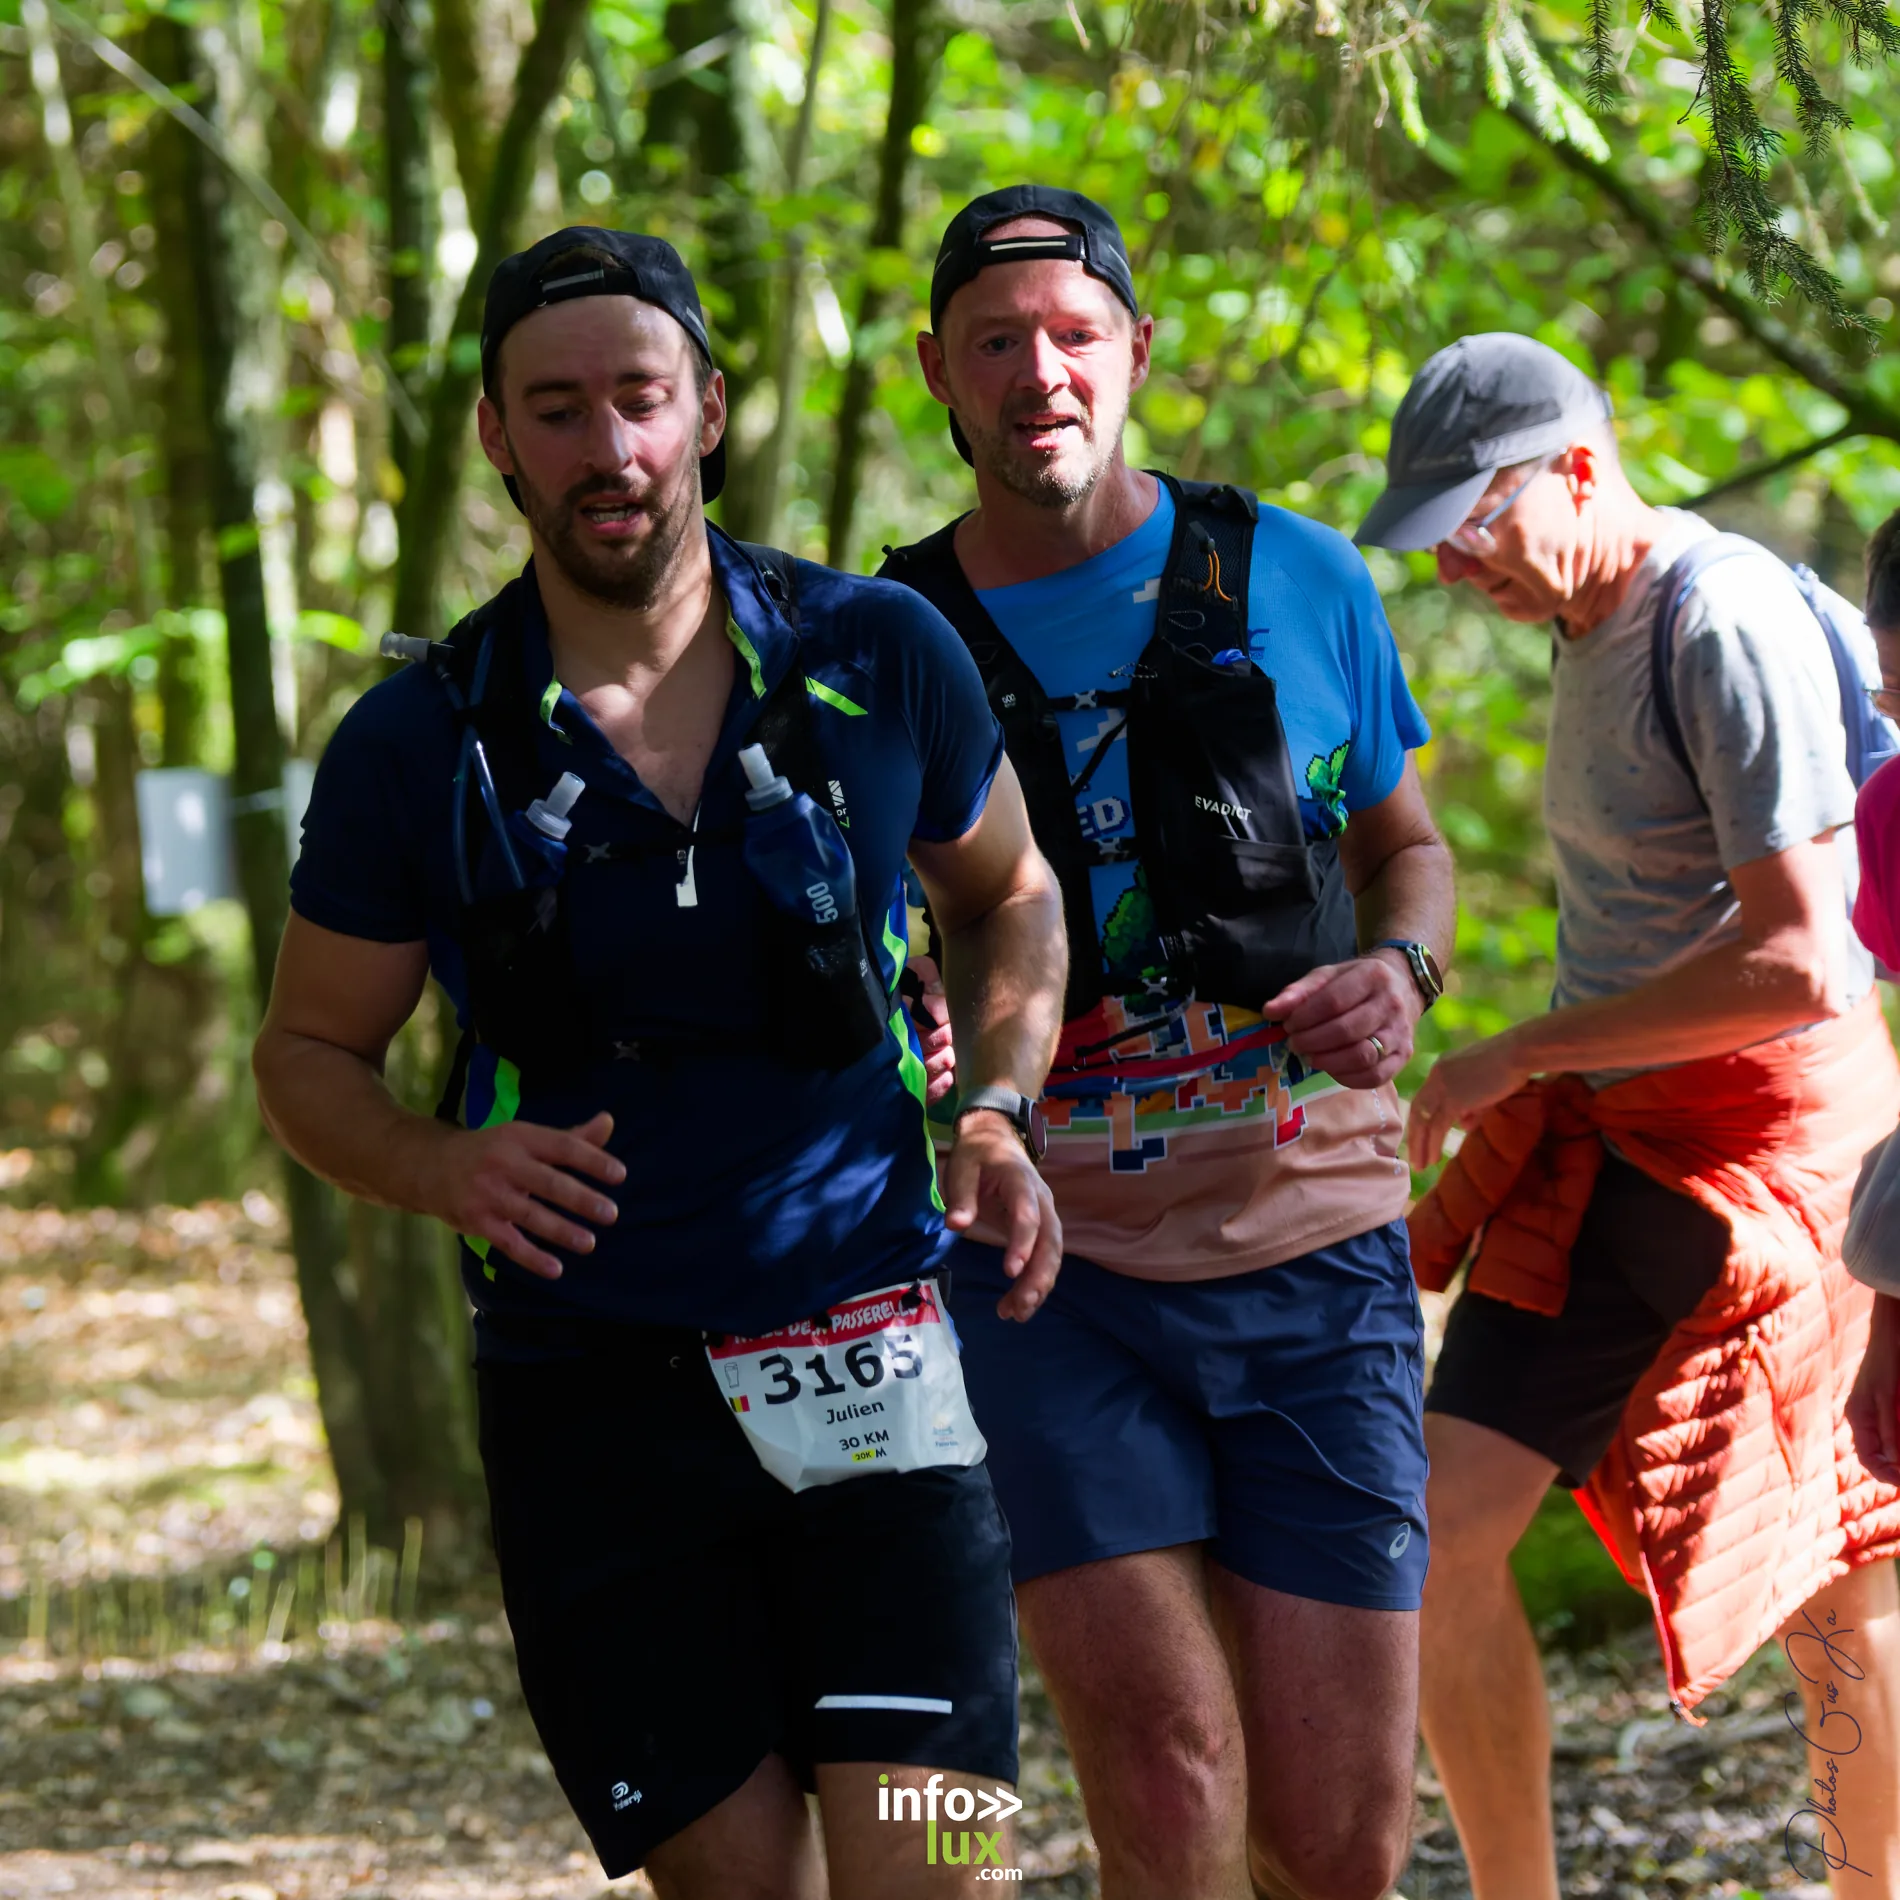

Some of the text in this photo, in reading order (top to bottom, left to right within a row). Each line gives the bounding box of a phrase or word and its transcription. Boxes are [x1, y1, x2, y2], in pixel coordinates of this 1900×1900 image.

[1195, 795, 1252, 821] EVADICT
[806, 881, 839, 924] 500
[759, 1334, 923, 1405] 3165
[826, 1401, 884, 1425] Julien
[839, 1429, 889, 1451] 30 KM
